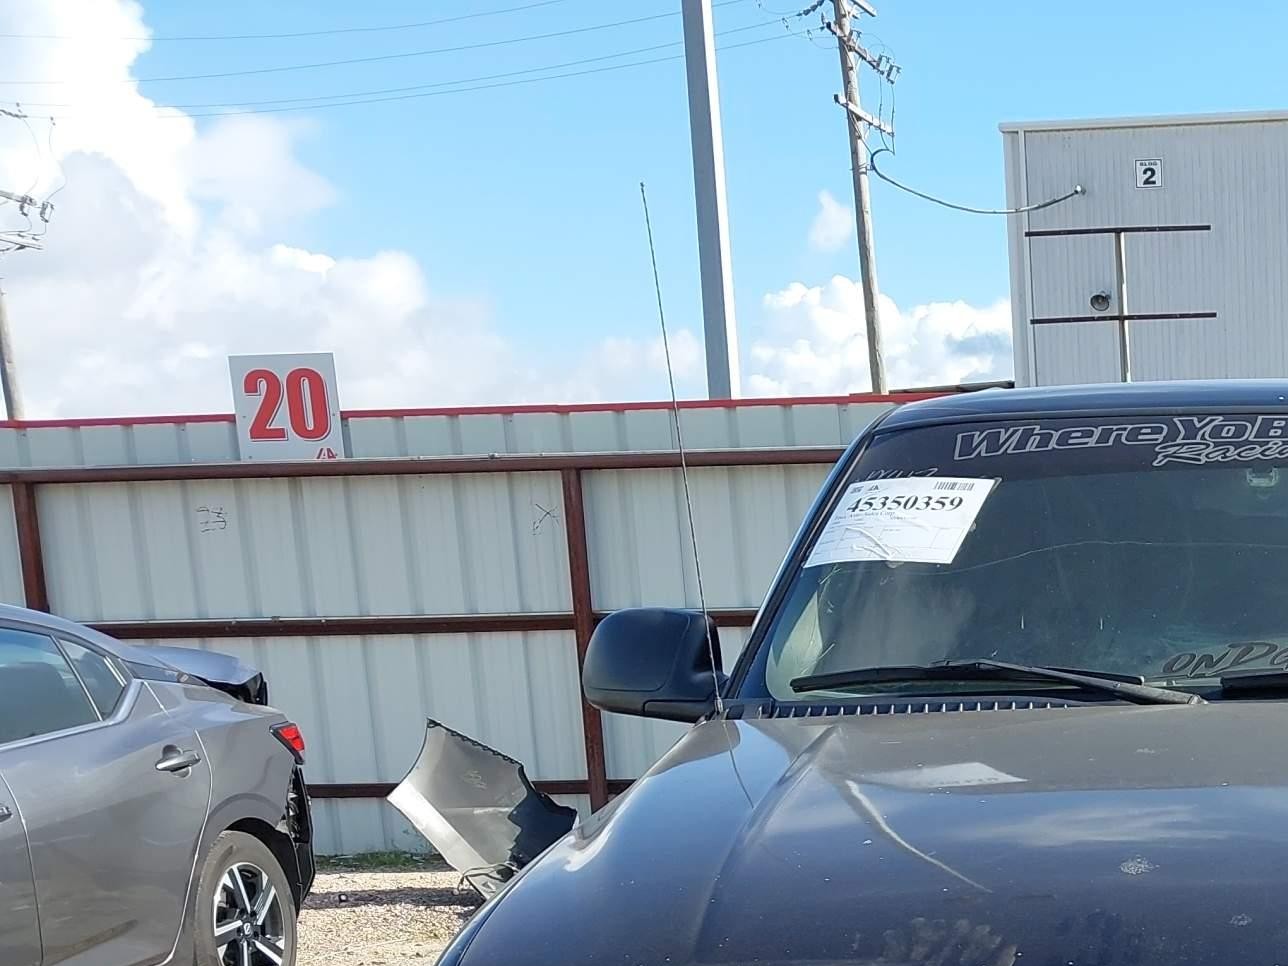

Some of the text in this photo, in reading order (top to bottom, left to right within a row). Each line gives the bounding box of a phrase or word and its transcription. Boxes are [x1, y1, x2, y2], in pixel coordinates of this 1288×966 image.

[1142, 167, 1156, 185] 2
[243, 368, 332, 443] 20
[846, 495, 964, 513] 45350359
